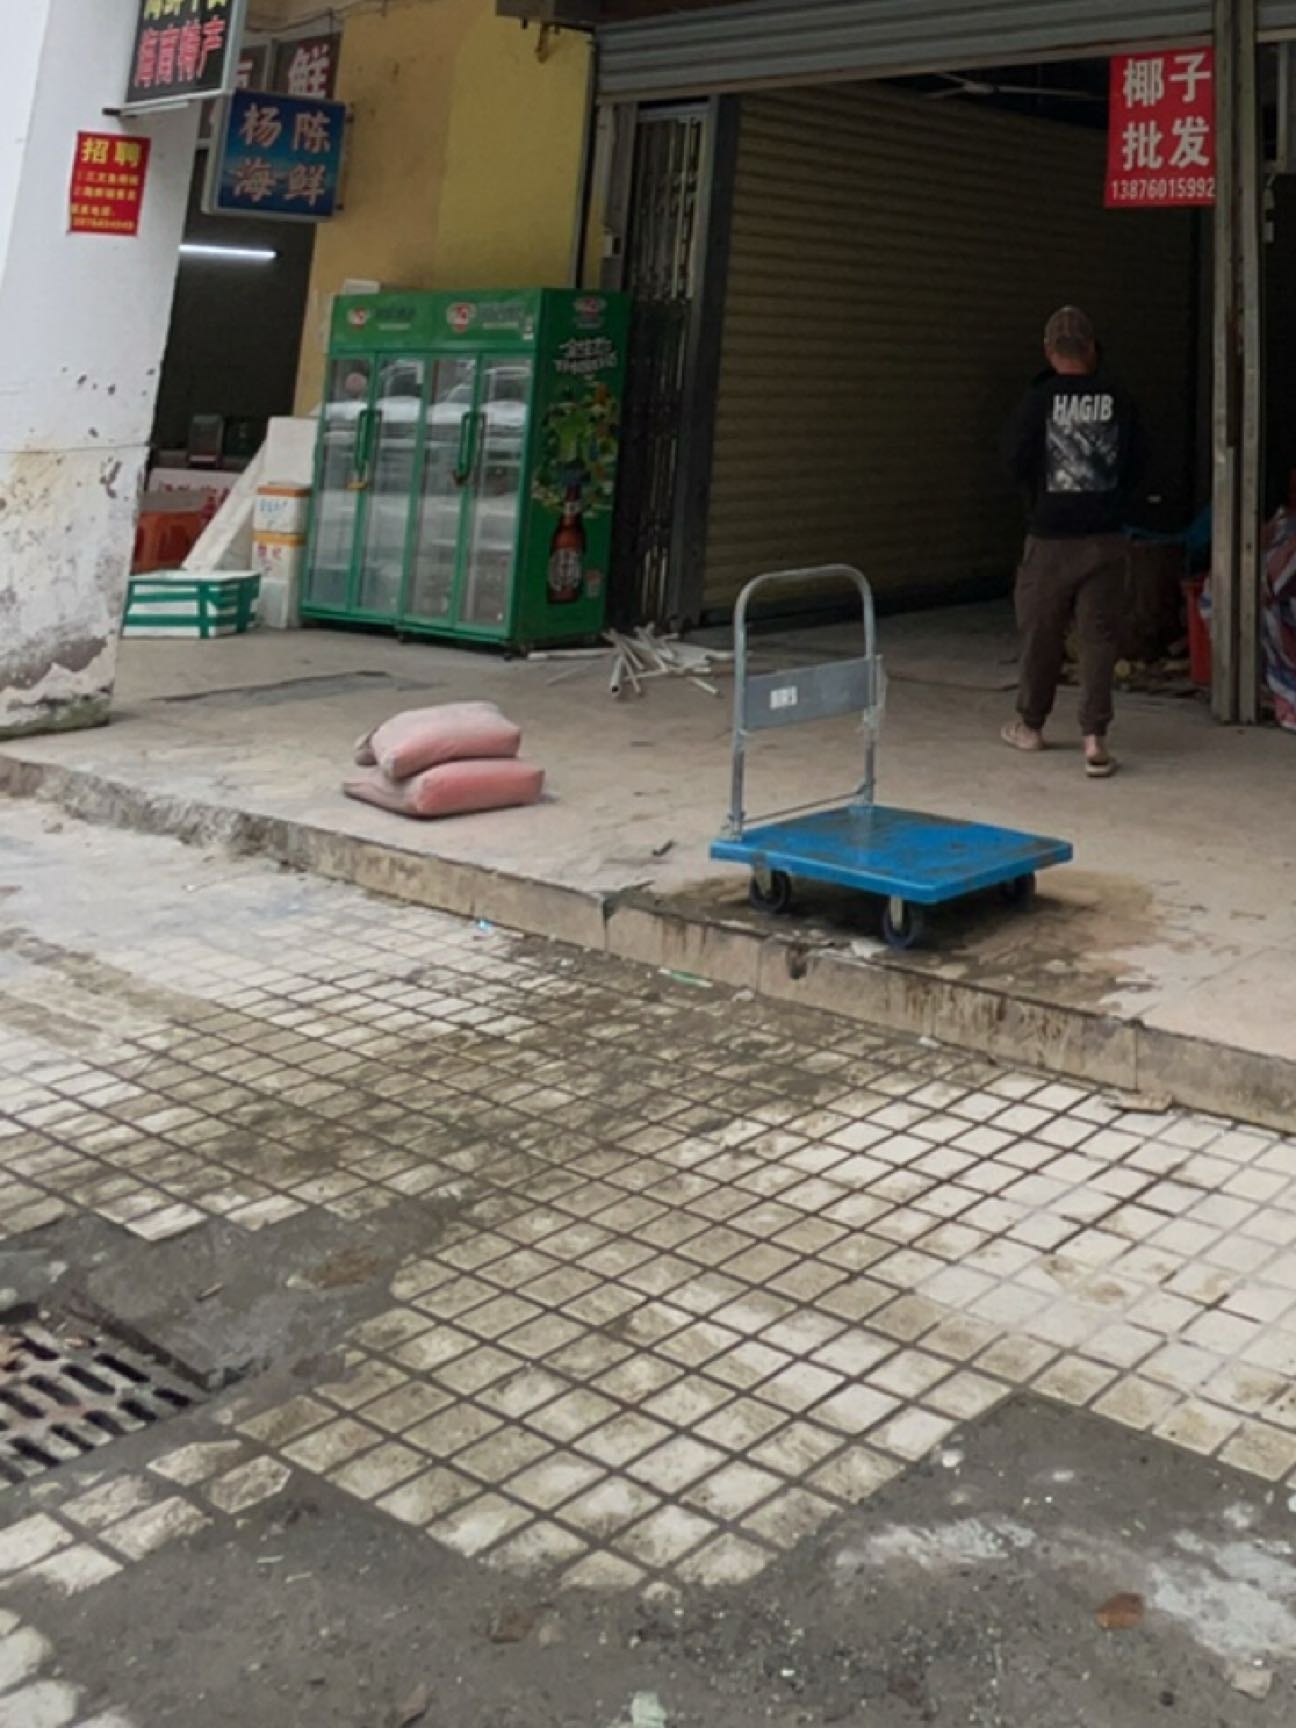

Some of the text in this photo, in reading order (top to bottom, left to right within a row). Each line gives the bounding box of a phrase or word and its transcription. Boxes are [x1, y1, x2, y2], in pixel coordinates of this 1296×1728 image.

[1122, 53, 1212, 109] 椰子
[239, 101, 331, 154] 杨陈
[1121, 116, 1211, 171] 批发
[233, 156, 326, 208] 海鲜
[1112, 177, 1216, 201] 13876015992
